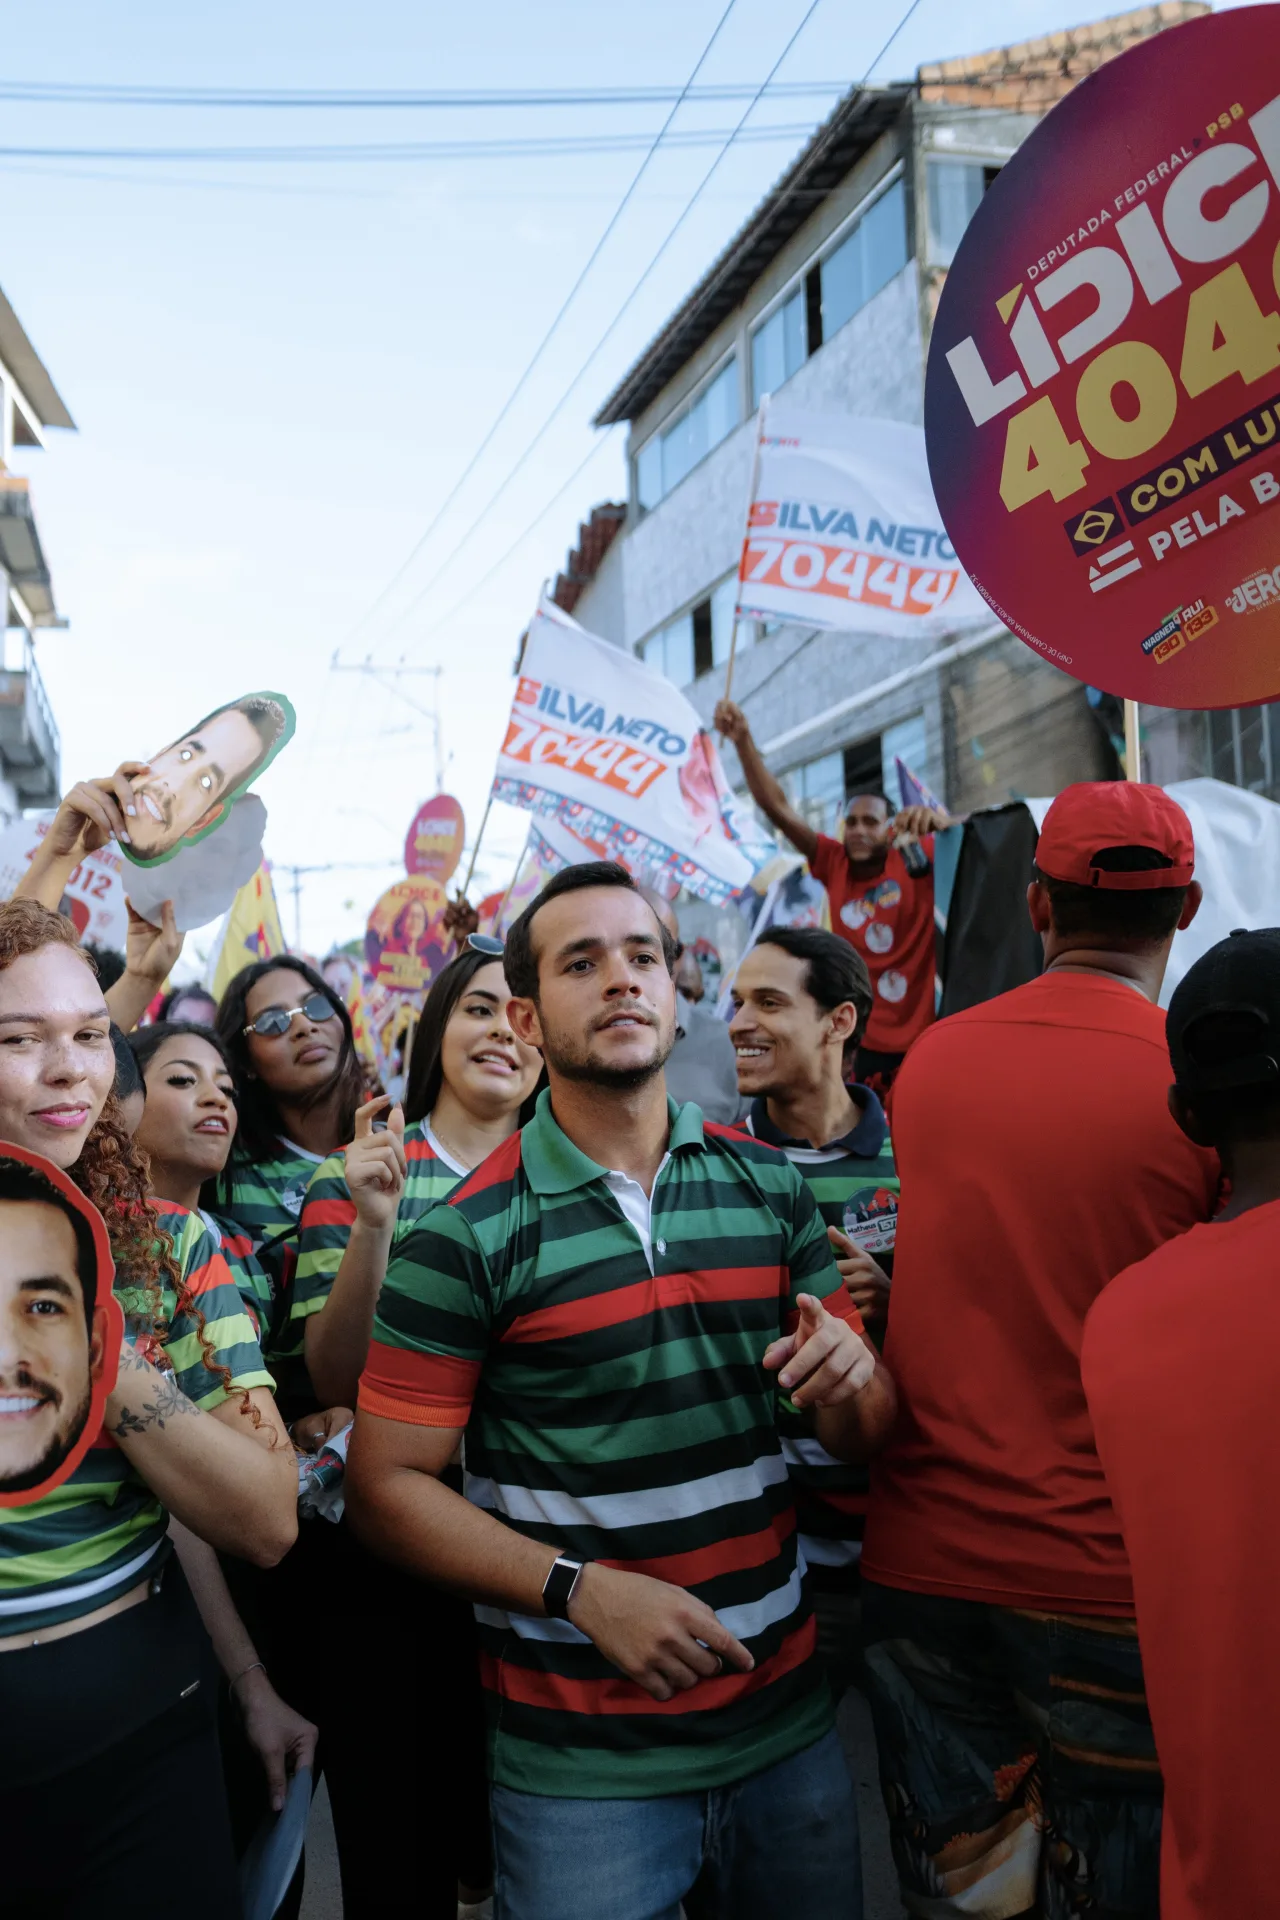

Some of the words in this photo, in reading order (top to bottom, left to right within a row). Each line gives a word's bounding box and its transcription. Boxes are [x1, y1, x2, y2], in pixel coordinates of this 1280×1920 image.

[1027, 209, 1112, 280] DEPUTADA
[1114, 146, 1193, 211] FEDERAL
[1206, 103, 1245, 139] PSB
[999, 240, 1280, 512] 404
[1131, 445, 1219, 513] COM
[1223, 402, 1280, 460] LU
[1148, 494, 1246, 561] PELA
[747, 540, 954, 611] 70444
[1014, 622, 1048, 650] CAMPANHA
[1142, 621, 1176, 650] WAGNER
[1182, 599, 1204, 622] RUI
[1155, 634, 1180, 659] 130
[1187, 609, 1213, 635] 133
[1047, 646, 1057, 656] DE
[1056, 651, 1073, 664] CNPJ
[606, 714, 686, 756] NETO
[847, 1222, 877, 1233] Matheus
[265, 1272, 277, 1300] FILA
